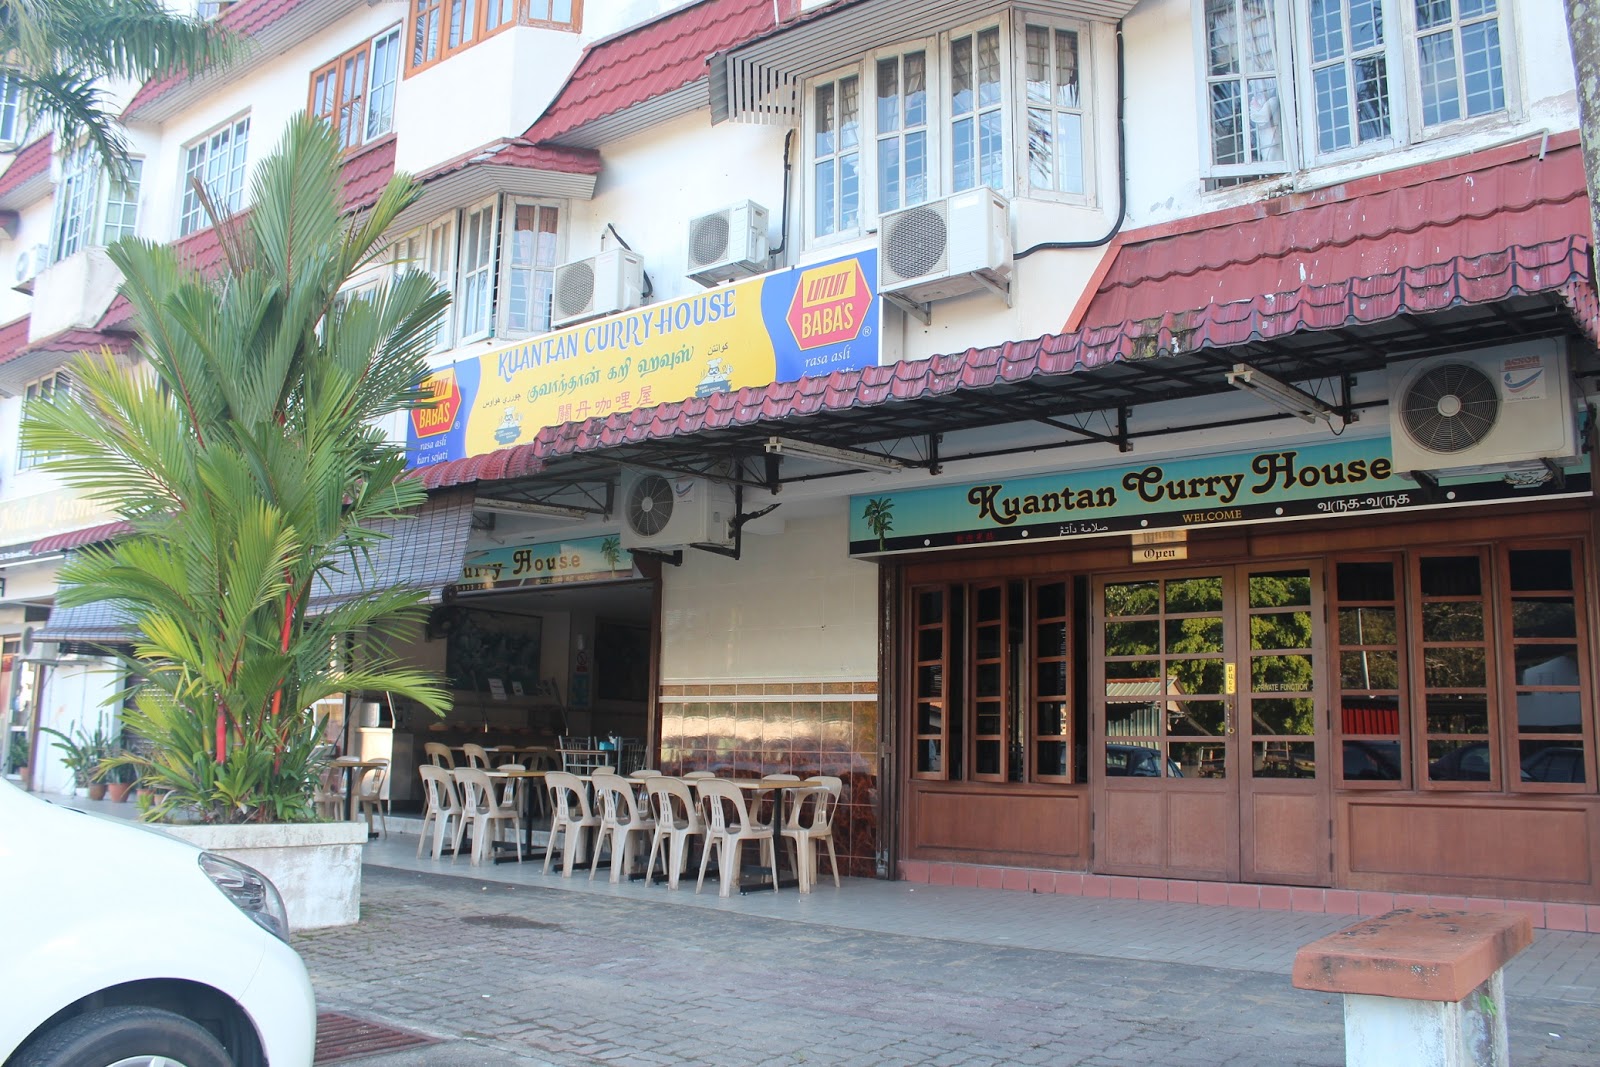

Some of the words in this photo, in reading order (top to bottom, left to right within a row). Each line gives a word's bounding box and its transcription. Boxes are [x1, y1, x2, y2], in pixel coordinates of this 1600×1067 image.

[498, 331, 578, 382] KUANTAN
[584, 311, 654, 353] CURRY
[654, 289, 736, 335] HOUSE
[805, 352, 828, 368] rasa
[831, 344, 852, 361] asli
[420, 441, 434, 451] rasa
[435, 434, 447, 448] asli
[967, 484, 1118, 526] Kuantan
[1122, 465, 1245, 504] Curry
[1251, 451, 1392, 495] House
[1182, 509, 1242, 523] WELCOME
[1143, 548, 1175, 559] Open
[463, 563, 503, 581] urry
[512, 550, 580, 575] House
[1280, 683, 1308, 691] FUNCTION
